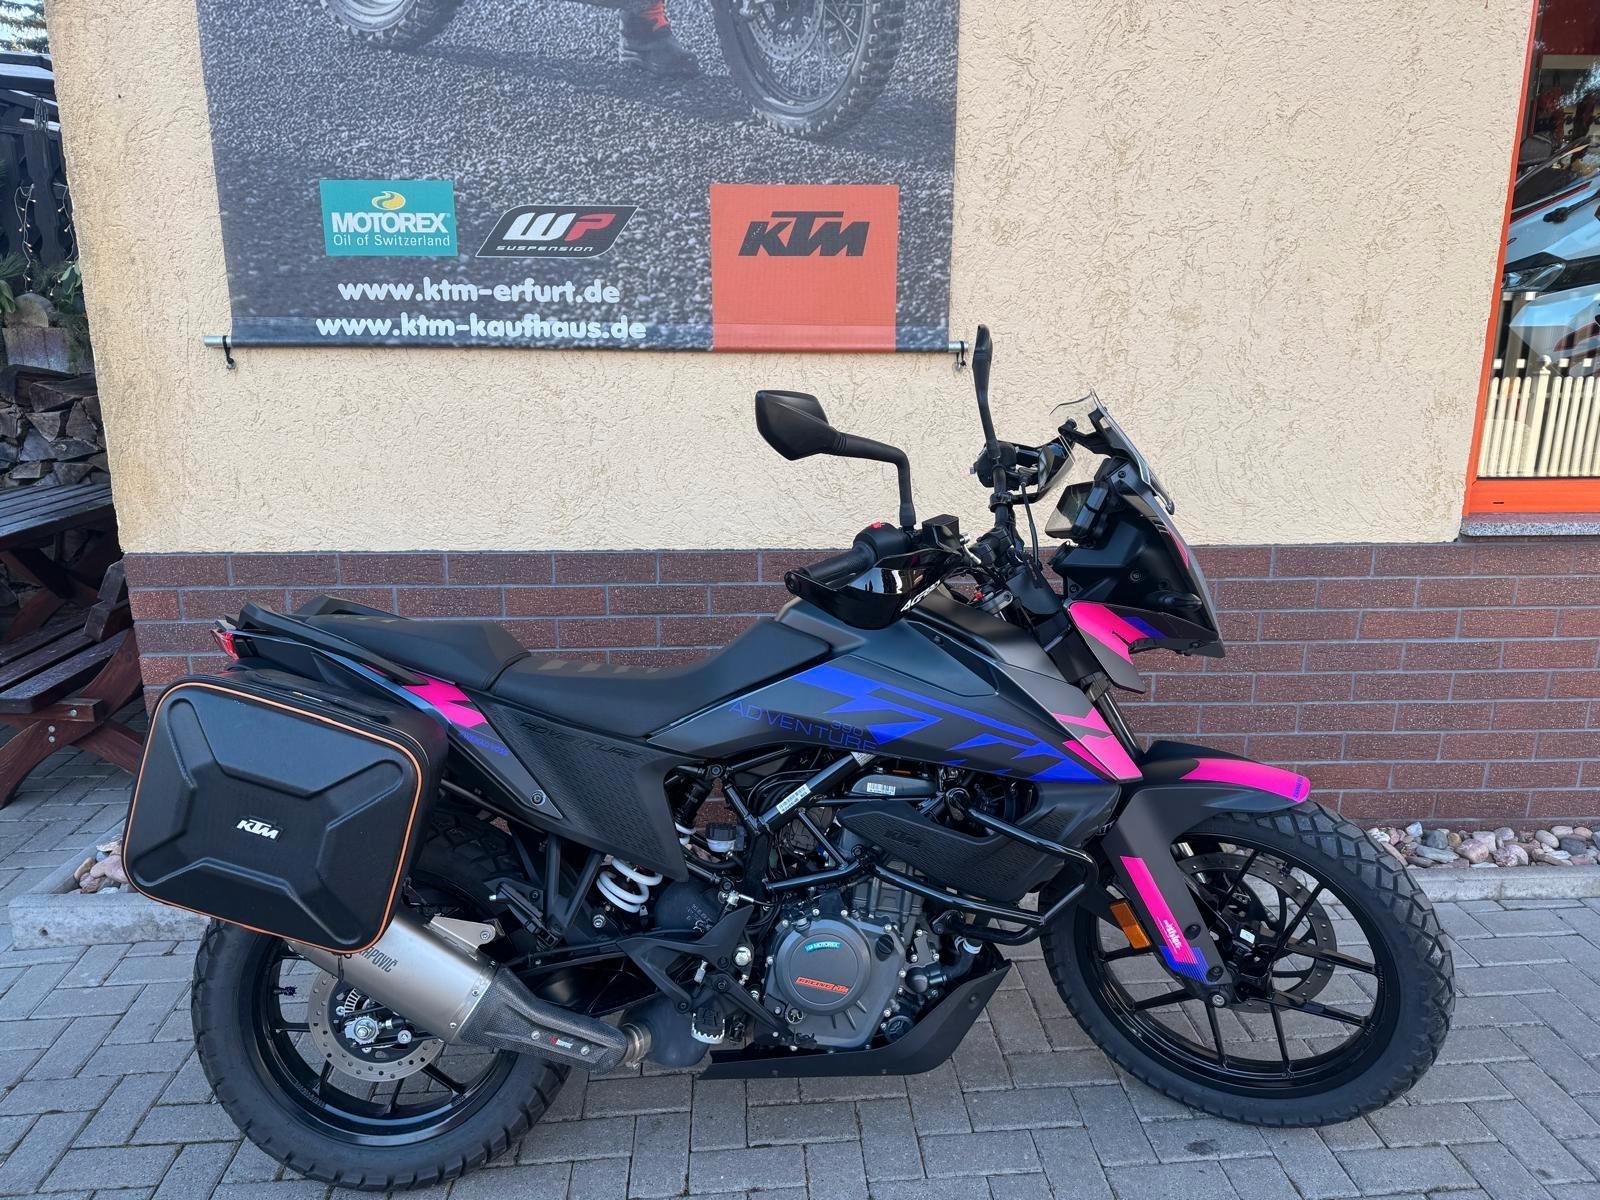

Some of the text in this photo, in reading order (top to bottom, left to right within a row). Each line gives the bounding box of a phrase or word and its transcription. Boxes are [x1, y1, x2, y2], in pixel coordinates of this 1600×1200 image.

[331, 212, 449, 233] MOTOREX
[502, 212, 616, 241] WP
[738, 211, 870, 256] KTM
[333, 234, 450, 246] Oil of Switzerland
[337, 277, 621, 303] www.ktm-erfurt.de
[315, 312, 646, 339] www.ktm-kaufhaus.de
[728, 700, 877, 750] ADVENTURE
[236, 819, 279, 840] KTM
